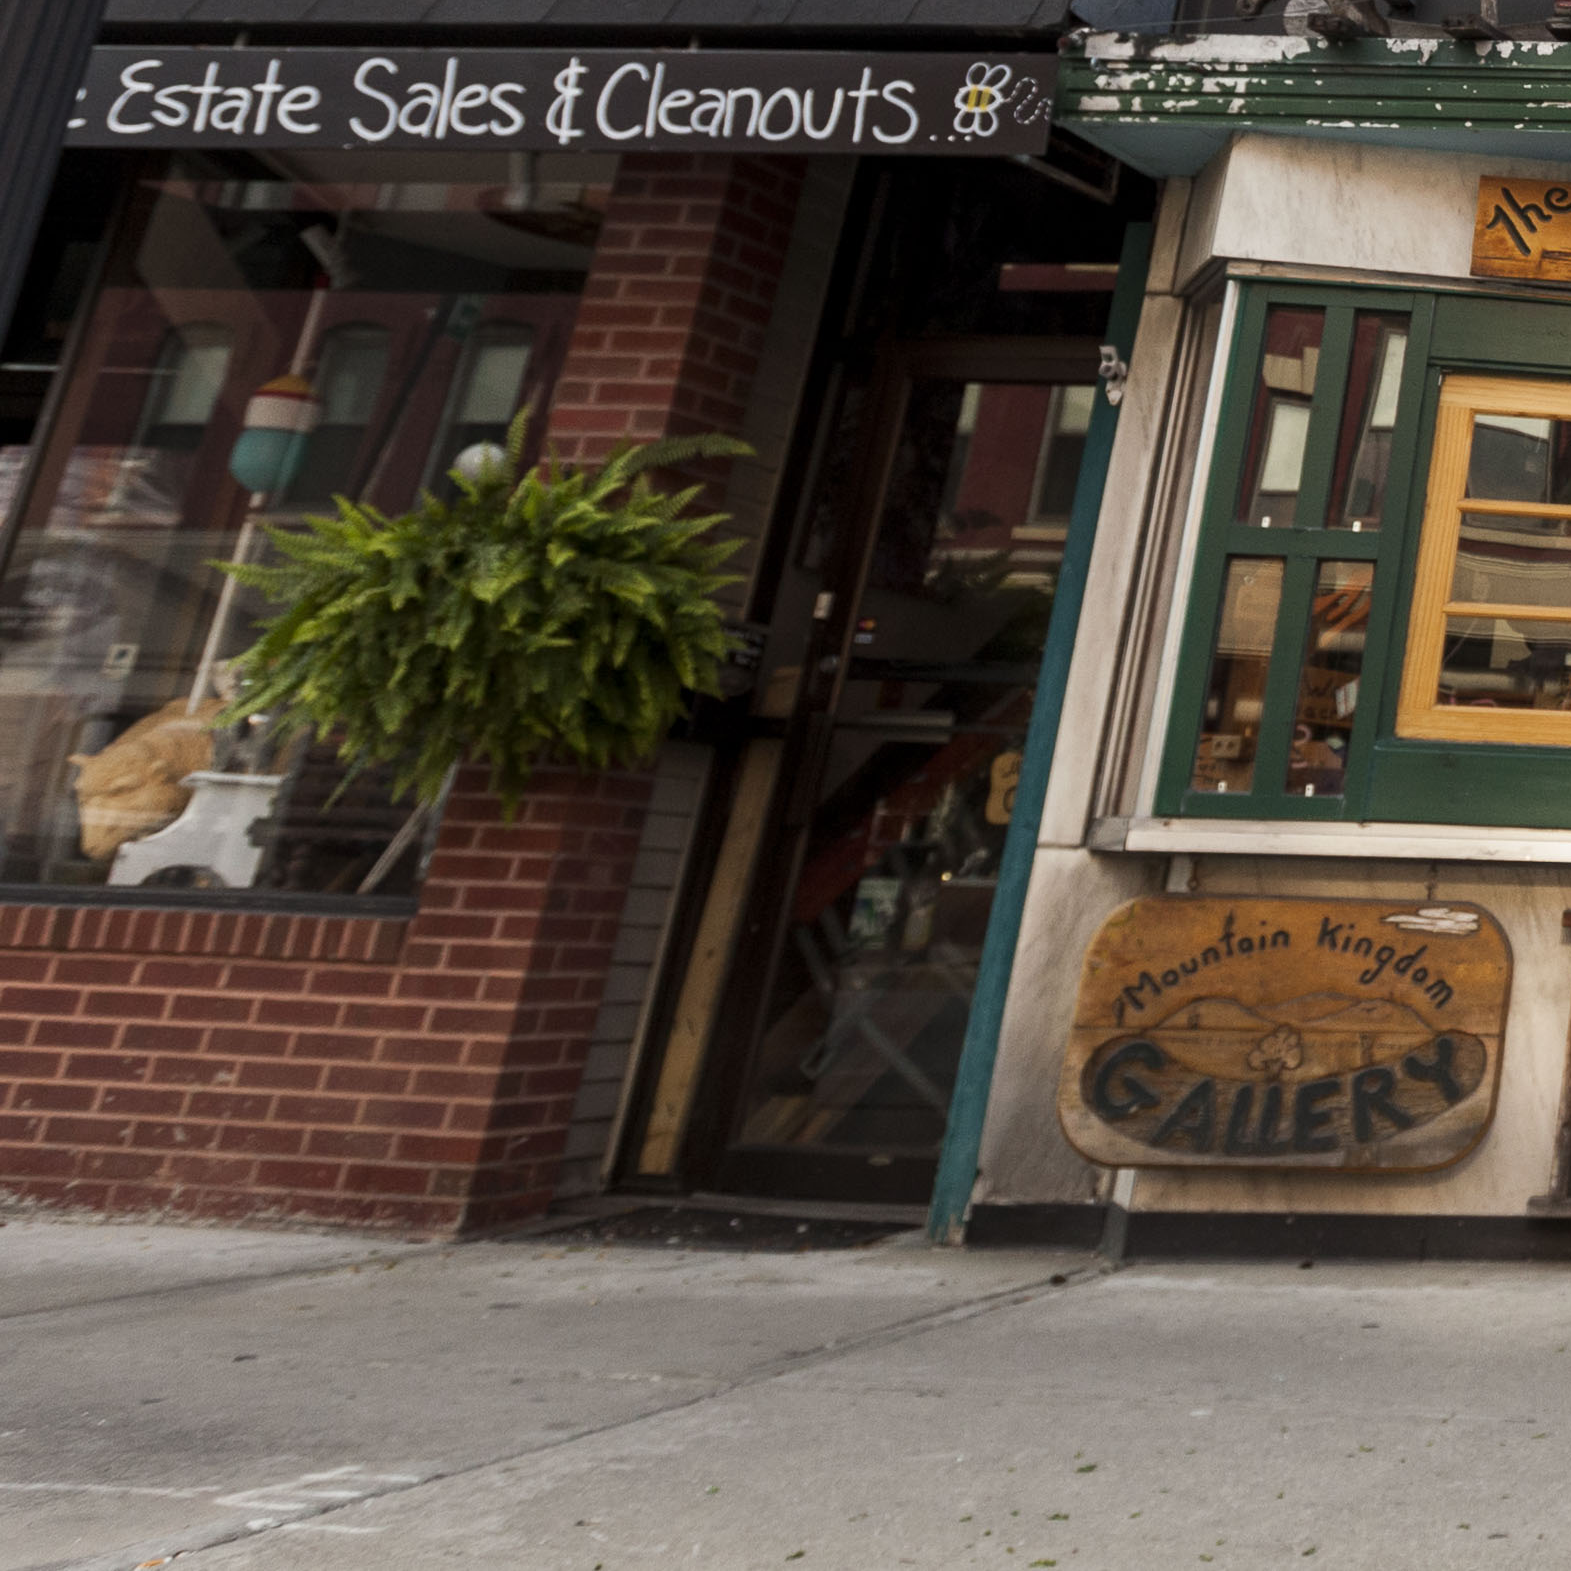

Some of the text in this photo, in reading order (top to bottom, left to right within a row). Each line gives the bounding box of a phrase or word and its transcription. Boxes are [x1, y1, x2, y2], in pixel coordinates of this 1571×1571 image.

[106, 58, 322, 136] Estate
[348, 55, 526, 143] Sales
[545, 55, 590, 148] &
[597, 60, 921, 146] Cleanouts
[1113, 910, 1456, 1020] Mountain Kingdom
[1093, 1034, 1465, 1158] GALLERY
